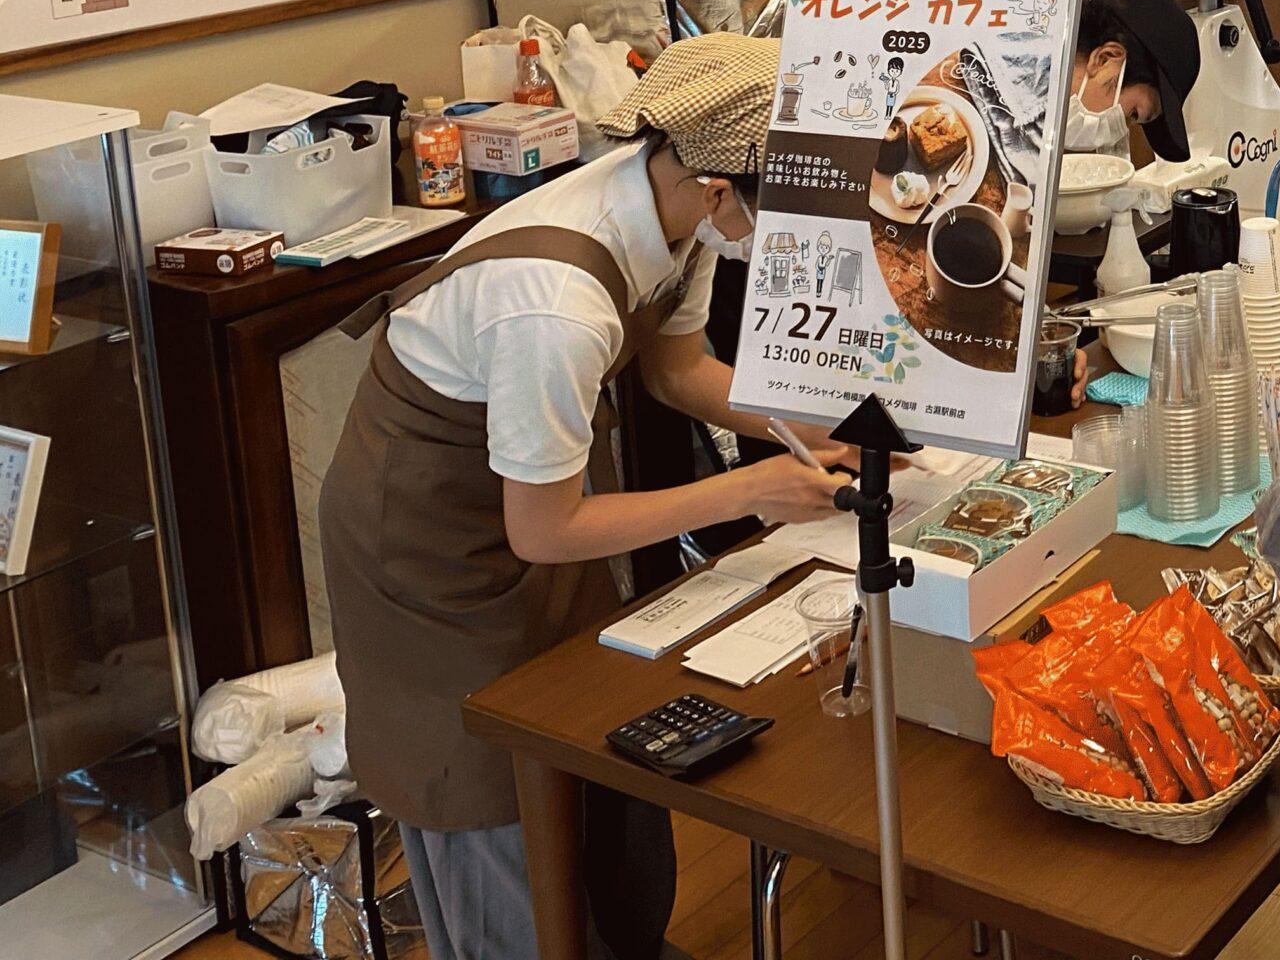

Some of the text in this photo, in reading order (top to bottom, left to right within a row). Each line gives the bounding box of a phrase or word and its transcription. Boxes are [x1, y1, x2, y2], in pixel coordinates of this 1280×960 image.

[888, 35, 926, 49] 2025
[527, 157, 536, 168] L
[768, 152, 831, 166] コメダ珈琲店の
[766, 163, 848, 180] 美味しいお飲み物と
[765, 174, 866, 192] お菓子をお楽しみ下さい
[753, 302, 885, 351] 7/27 日曜日
[762, 344, 862, 372] 13:00 OPEN
